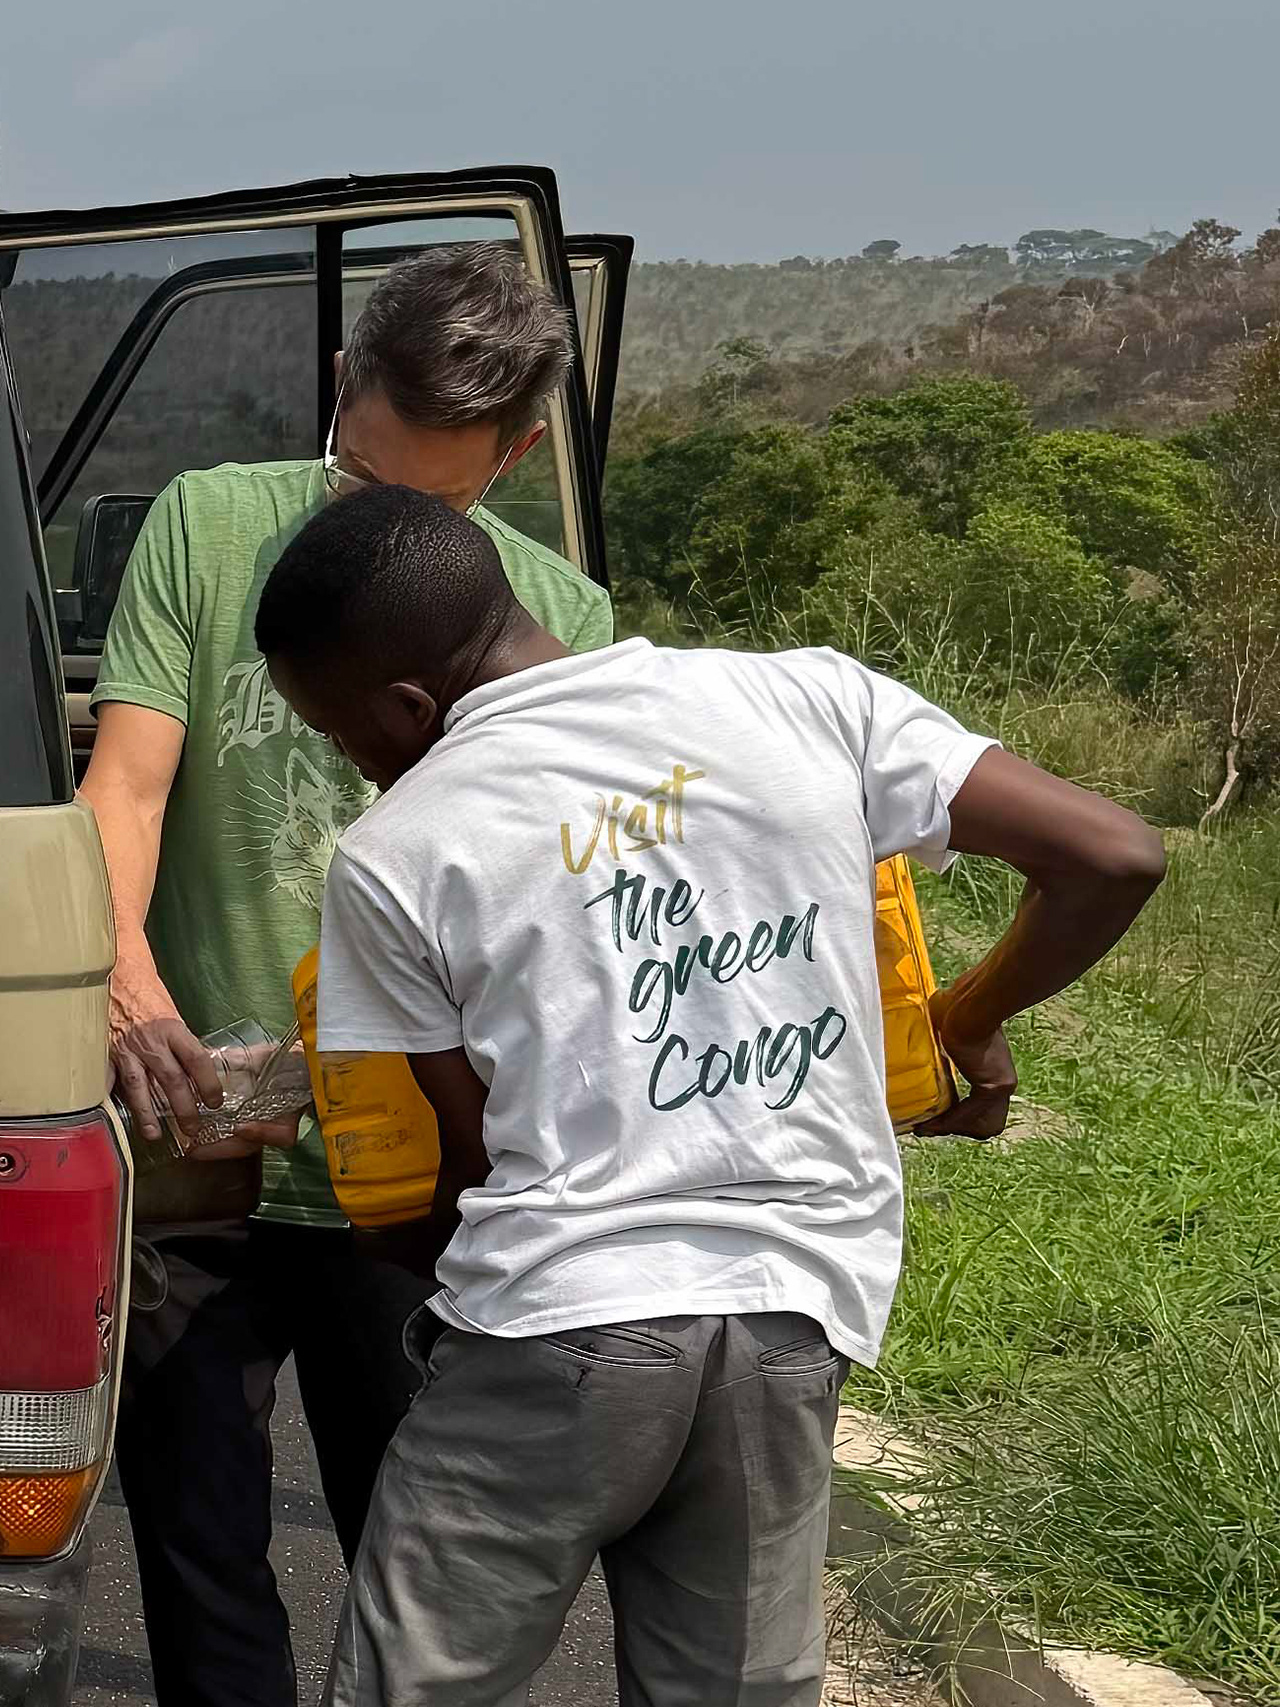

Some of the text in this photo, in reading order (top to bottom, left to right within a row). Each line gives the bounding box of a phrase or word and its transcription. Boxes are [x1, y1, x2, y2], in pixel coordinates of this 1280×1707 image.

[583, 868, 705, 953] the
[628, 902, 820, 1043] green
[647, 1005, 847, 1112] Congo
